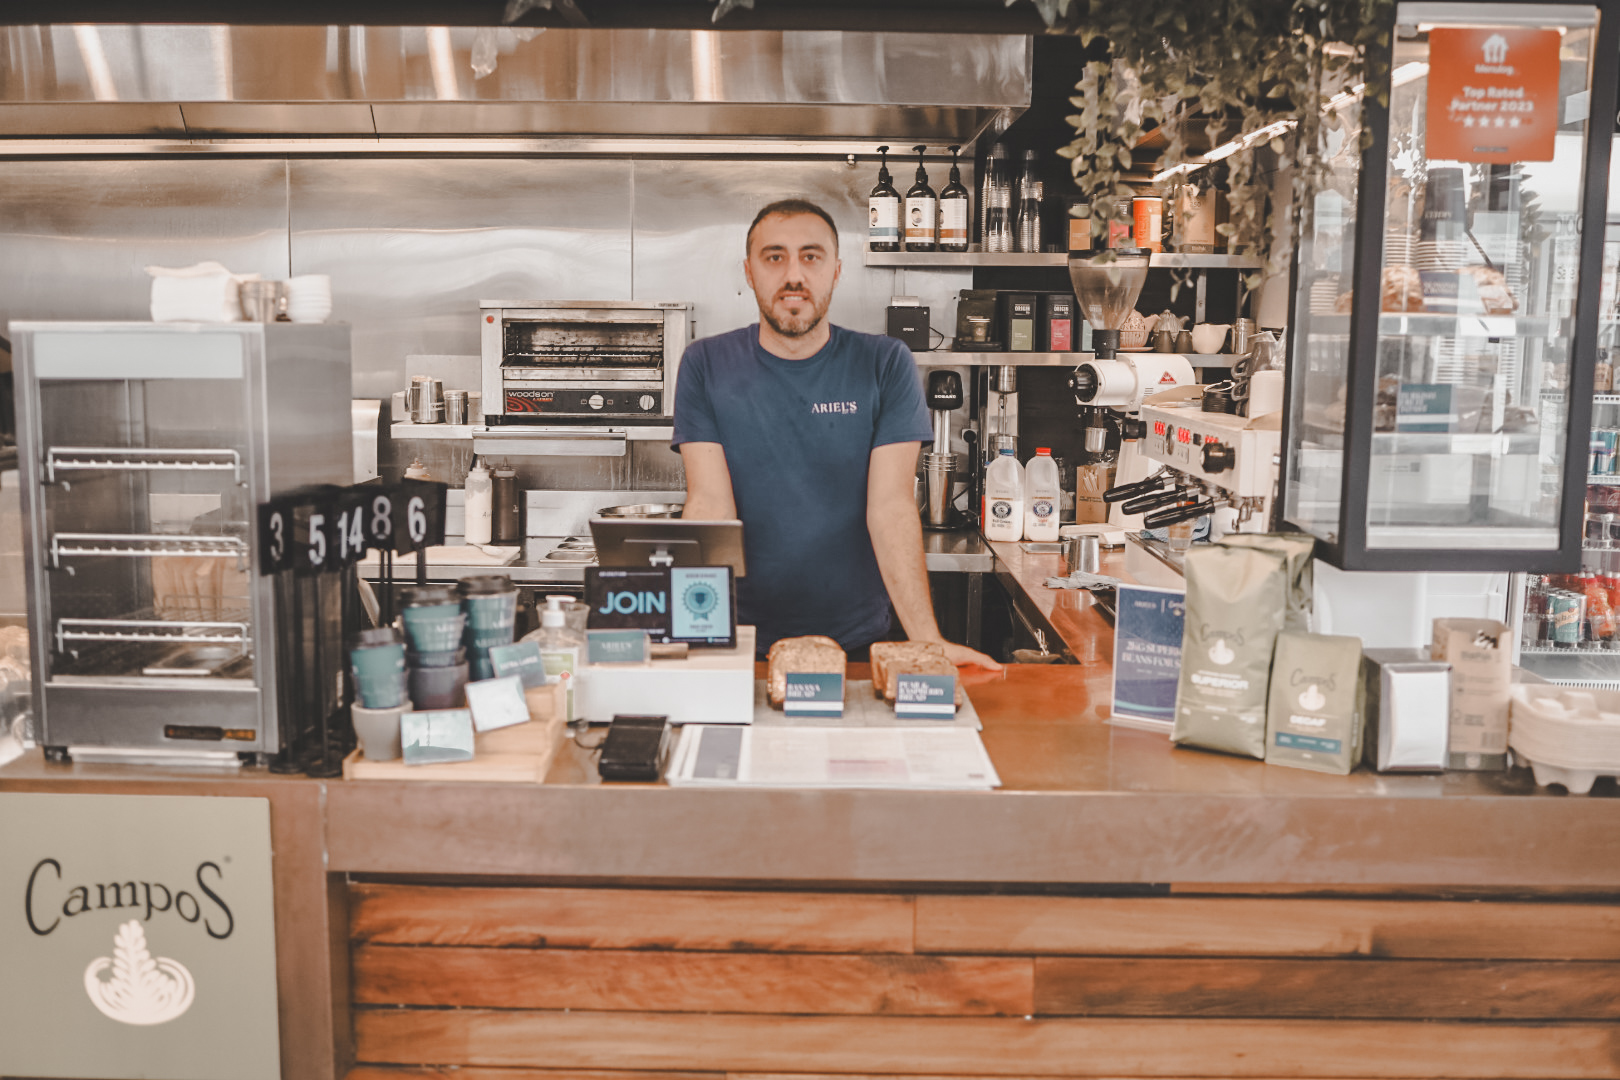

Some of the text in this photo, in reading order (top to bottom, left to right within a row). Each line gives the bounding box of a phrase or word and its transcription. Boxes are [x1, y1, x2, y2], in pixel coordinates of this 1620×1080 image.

[1450, 100, 1534, 112] Partner 2023
[1463, 86, 1524, 98] Top Rated
[811, 401, 858, 414] ARIEL'S
[270, 512, 284, 561] 3
[308, 514, 326, 565] 5
[337, 506, 363, 559] 14
[371, 495, 392, 540] 8
[408, 496, 427, 542] 6
[599, 591, 666, 615] JOIN
[25, 858, 234, 940] Campos
